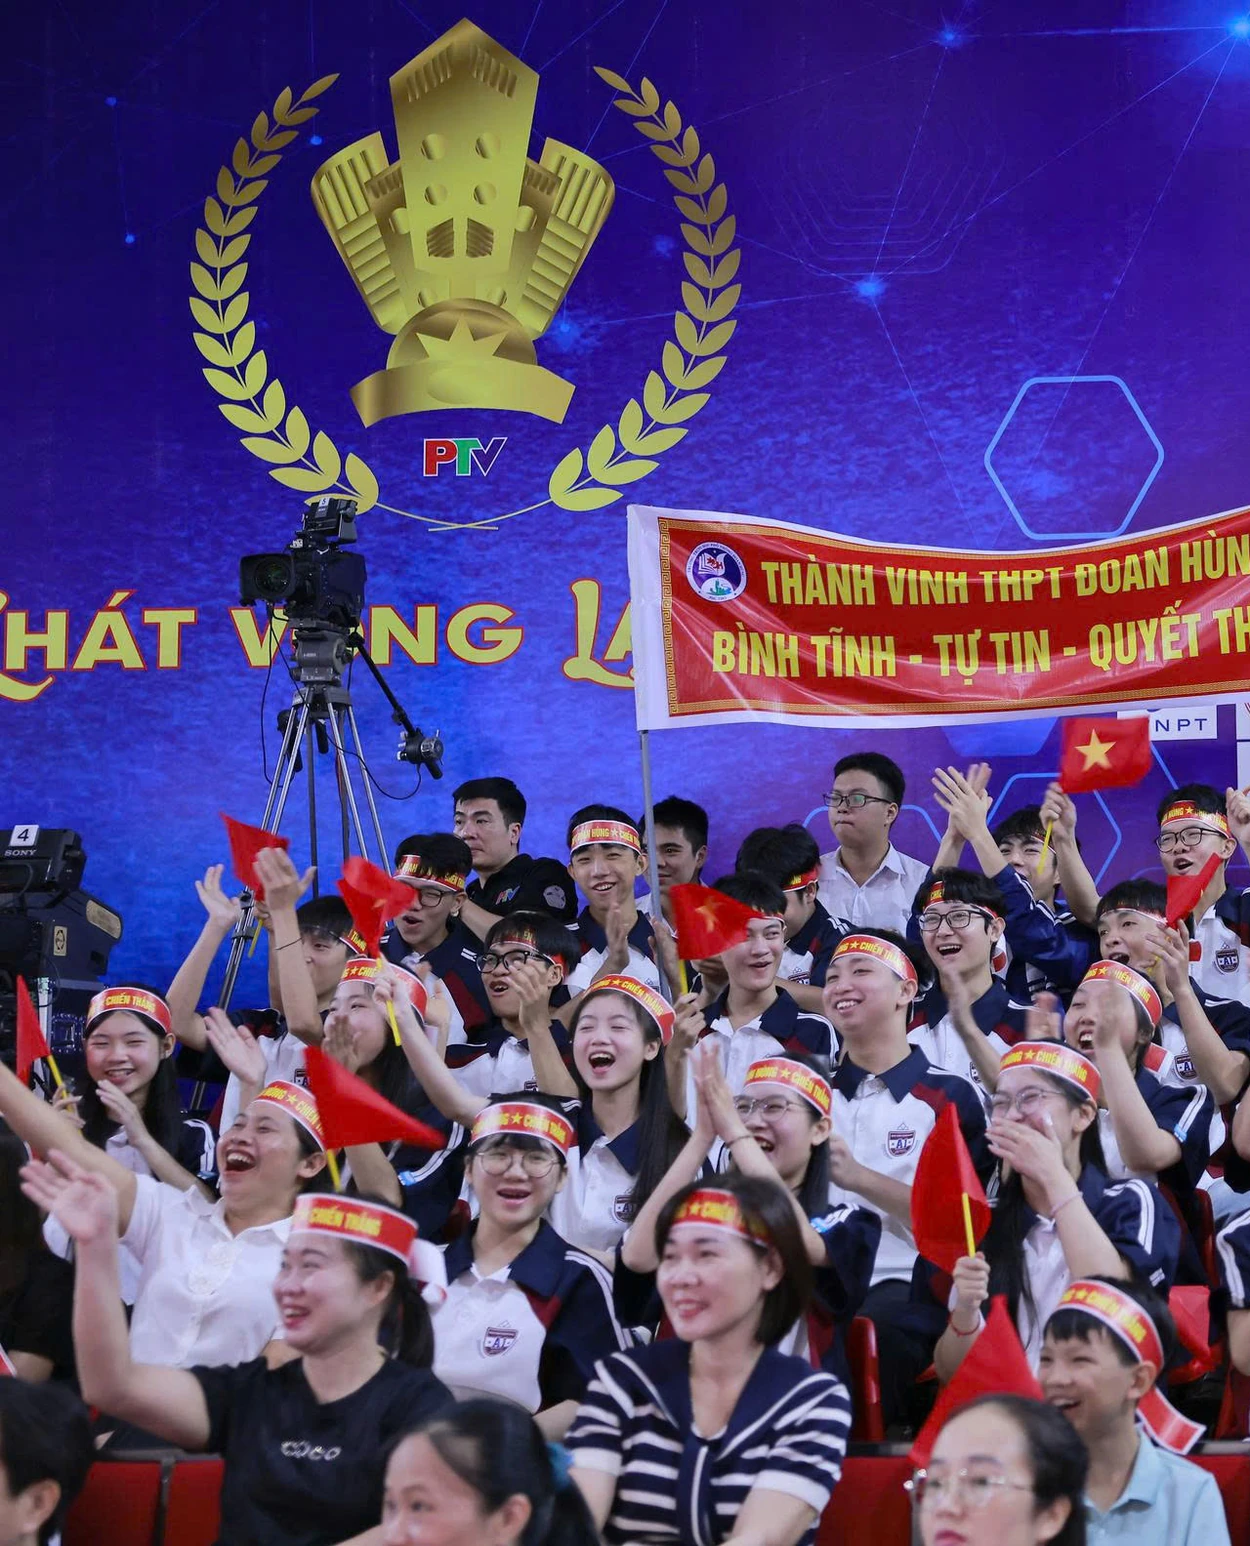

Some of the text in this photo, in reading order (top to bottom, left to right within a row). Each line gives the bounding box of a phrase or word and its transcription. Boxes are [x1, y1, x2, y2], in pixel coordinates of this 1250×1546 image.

[423, 437, 508, 476] PTV
[761, 554, 876, 605] THÀNH
[885, 566, 969, 605] VINH
[979, 566, 1063, 602] THPT
[1074, 546, 1169, 596] ĐOAN
[229, 602, 523, 668] VNG
[713, 621, 800, 678] BÌNH
[810, 626, 896, 677] TĨNH
[933, 629, 981, 685] TỰ
[989, 629, 1051, 676] TIN
[1088, 600, 1201, 671] QUYẾT
[4, 849, 37, 857] SONY
[17, 829, 29, 842] 4
[860, 941, 884, 957] CHIẾN
